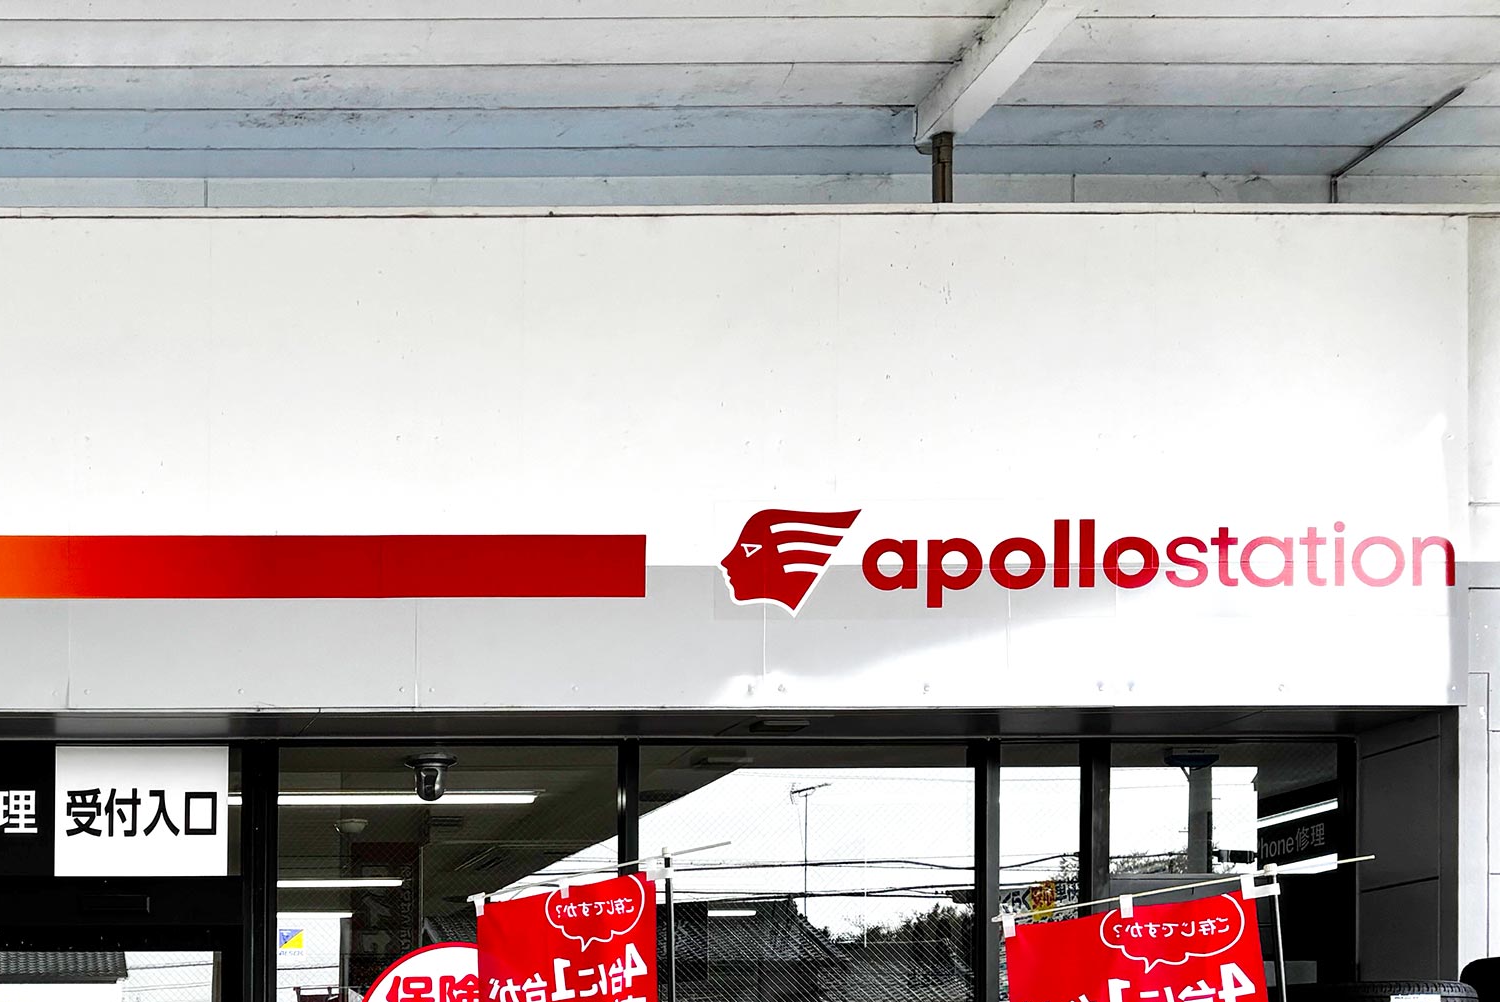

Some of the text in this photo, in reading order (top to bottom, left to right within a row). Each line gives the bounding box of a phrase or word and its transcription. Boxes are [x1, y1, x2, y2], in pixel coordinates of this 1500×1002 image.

[861, 519, 1456, 609] apollostation
[65, 787, 218, 838] 受付入口
[1257, 822, 1326, 860] hone修理
